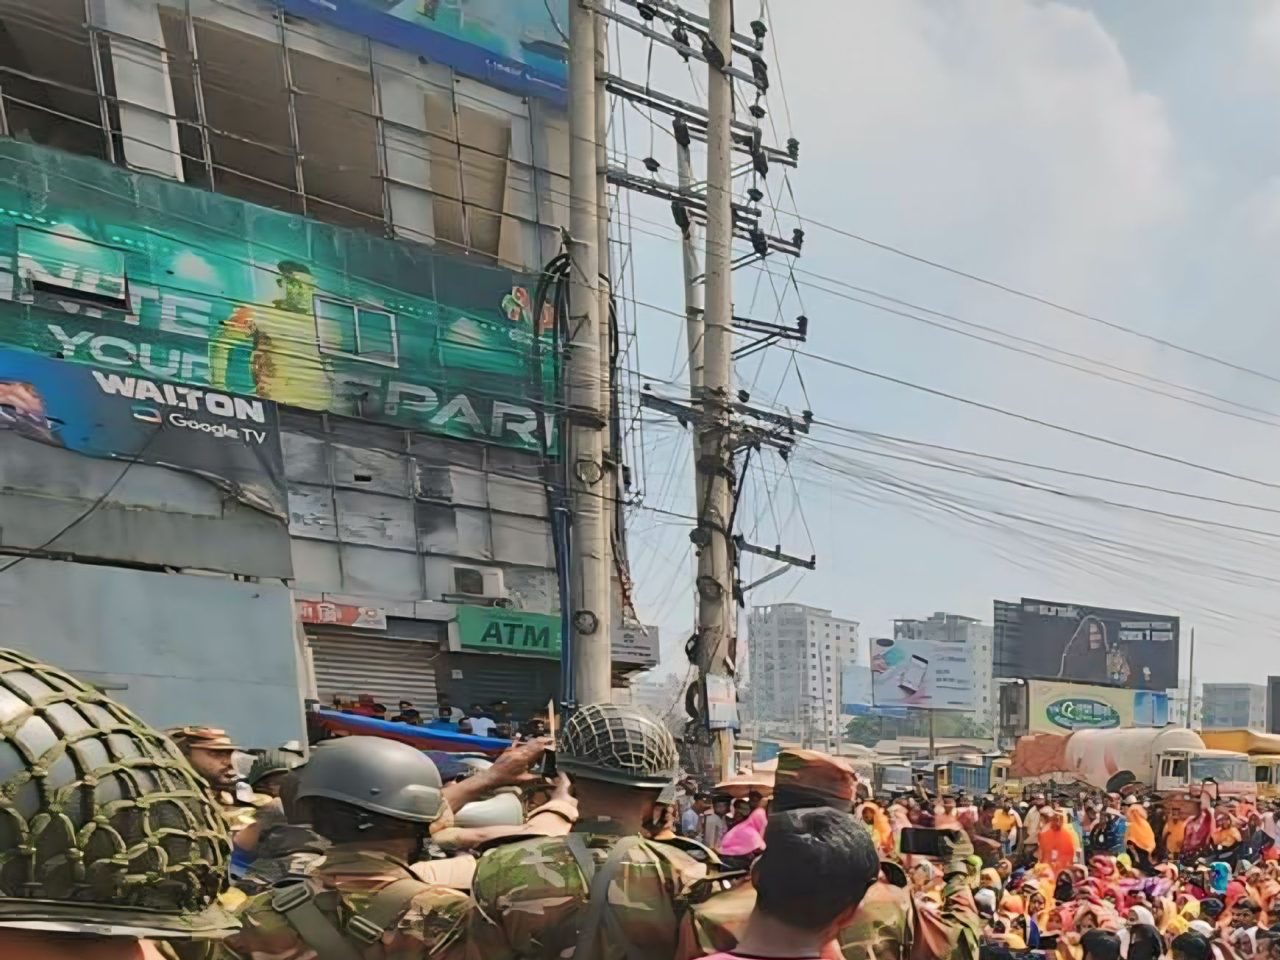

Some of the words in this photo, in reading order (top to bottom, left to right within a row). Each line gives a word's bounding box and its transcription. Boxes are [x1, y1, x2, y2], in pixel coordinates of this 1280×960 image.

[92, 370, 265, 423] WALTON
[169, 413, 239, 438] Google
[240, 427, 266, 445] TV
[481, 621, 550, 649] ATM
